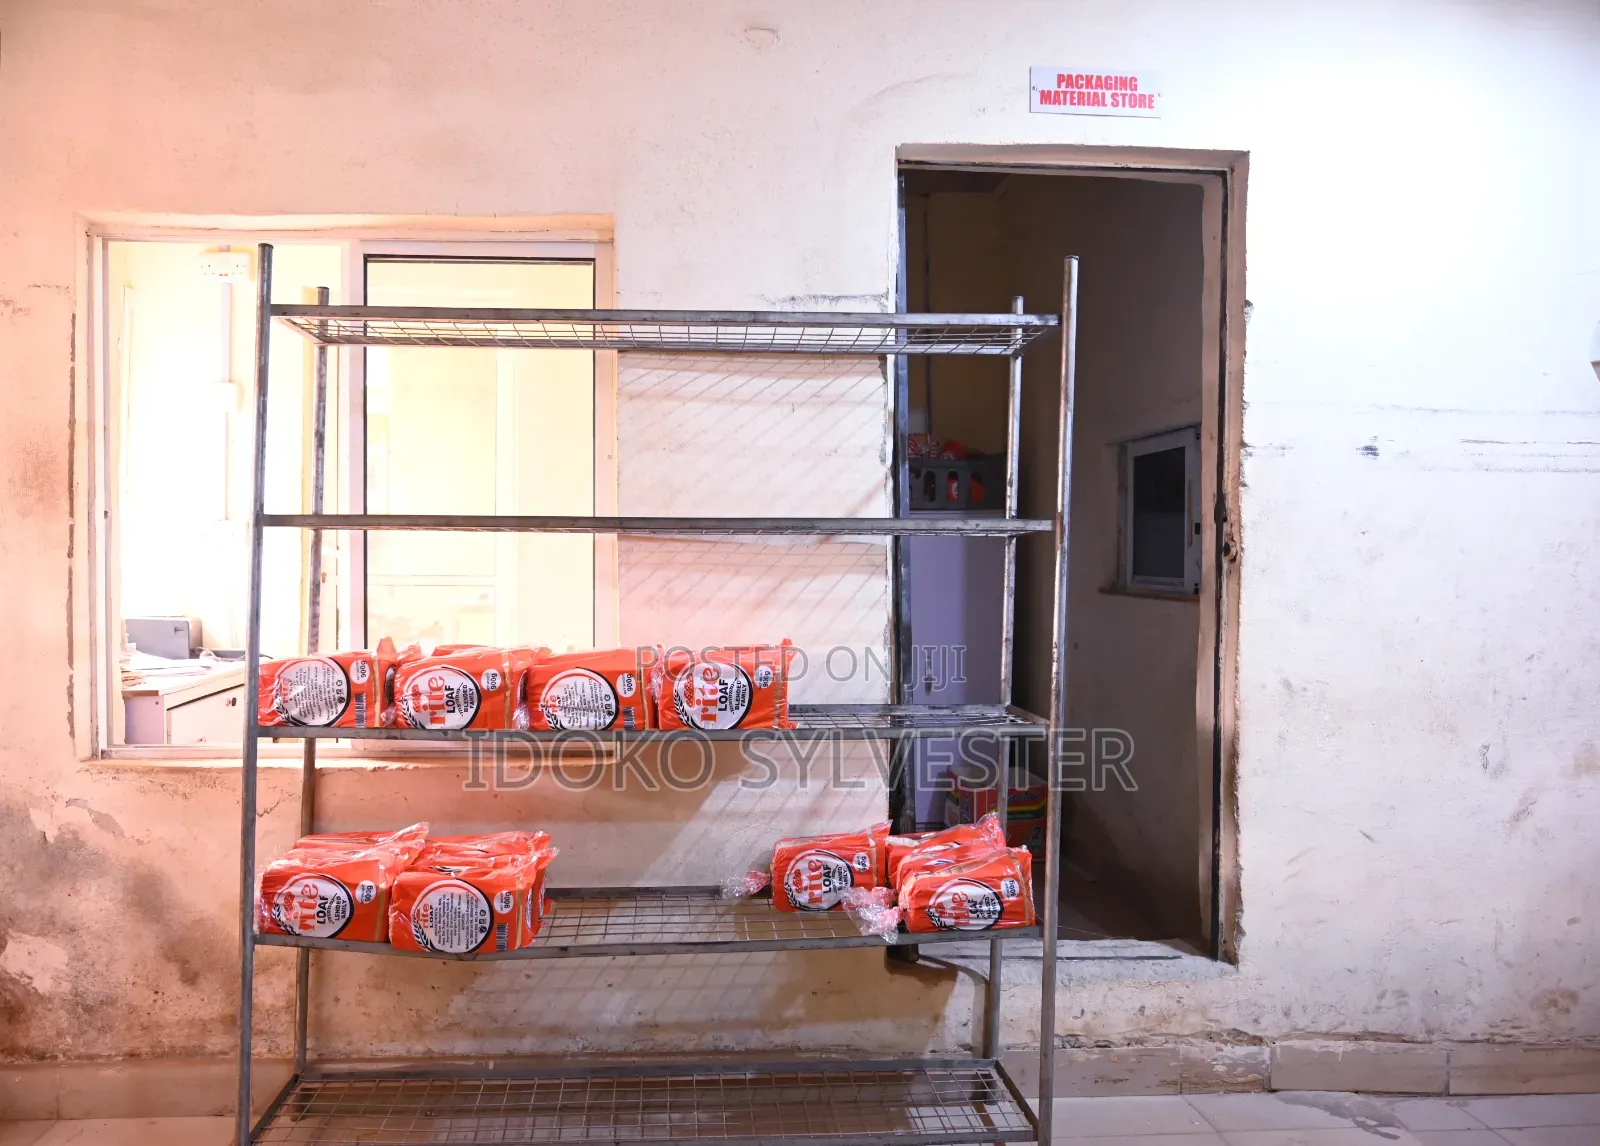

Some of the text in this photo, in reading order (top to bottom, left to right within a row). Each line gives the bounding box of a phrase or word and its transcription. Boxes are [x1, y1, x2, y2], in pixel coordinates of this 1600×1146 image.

[1056, 73, 1138, 91] PACKAGING
[1039, 90, 1154, 109] MATERIAL STORE
[490, 673, 498, 689] 900g
[696, 668, 720, 722] rite
[718, 679, 728, 711] LOAF
[734, 680, 742, 710] BLENDED
[422, 676, 446, 725] rite
[445, 685, 455, 713] LOAF
[804, 859, 823, 904] rite
[823, 864, 832, 893] LOAF
[293, 884, 319, 931] rite
[365, 885, 373, 902] 900g
[503, 892, 511, 908] 900g
[317, 895, 329, 924] LOAF
[339, 900, 347, 920] AMILY
[420, 903, 430, 928] rite
